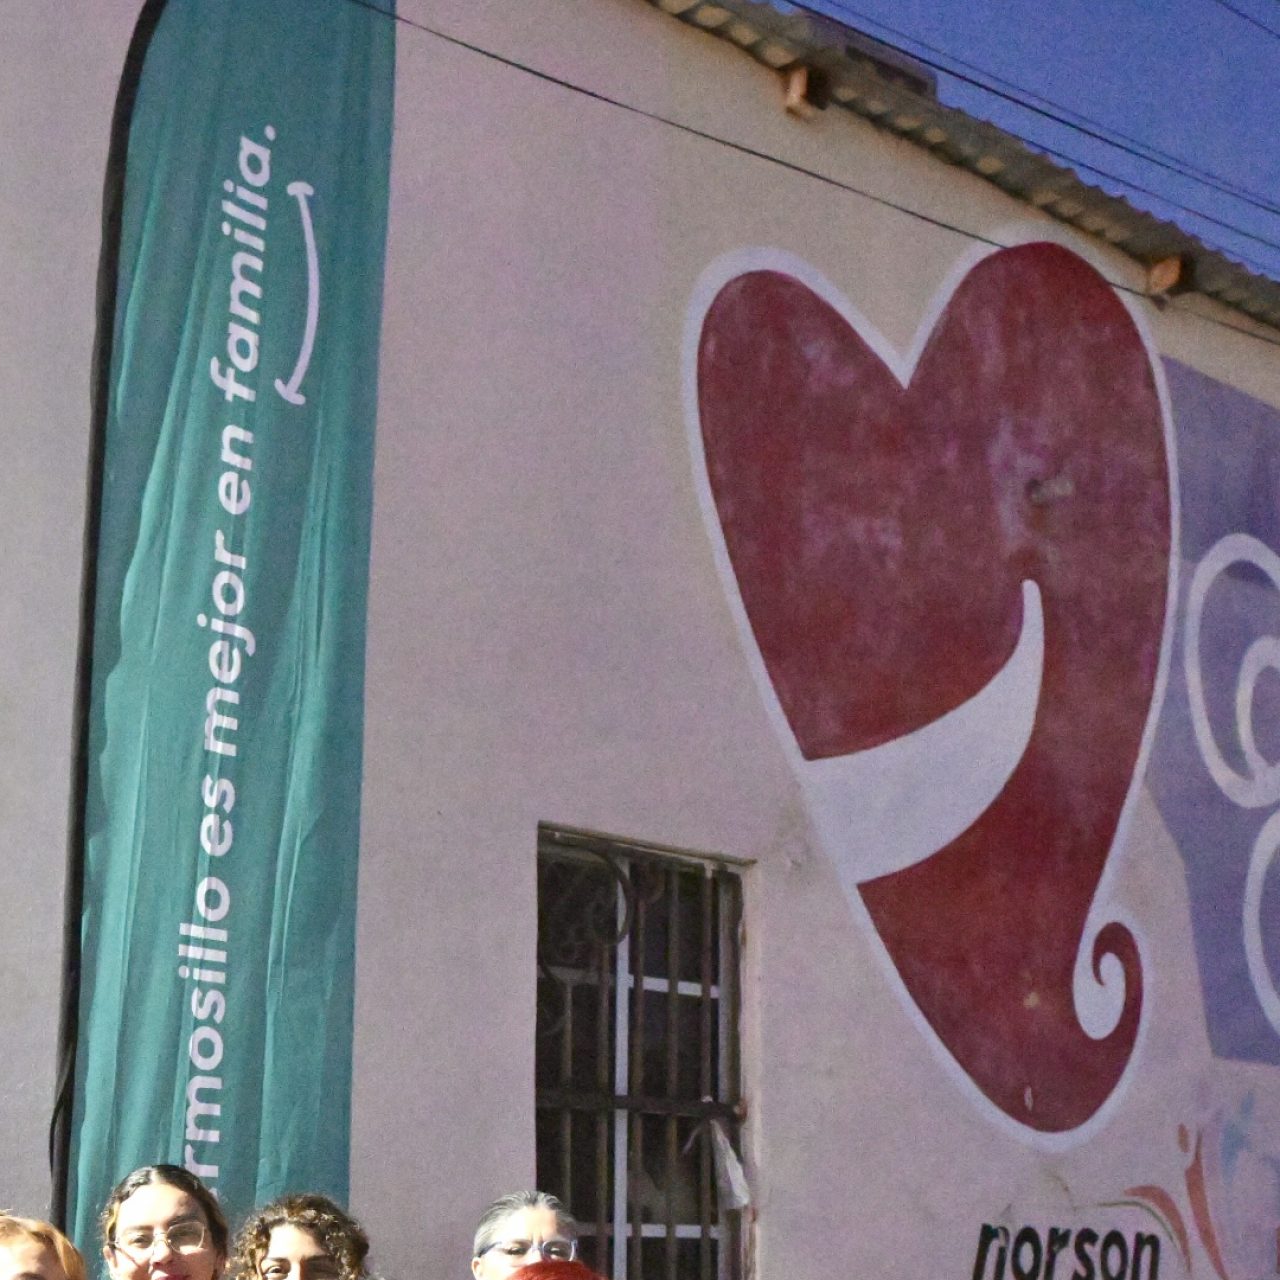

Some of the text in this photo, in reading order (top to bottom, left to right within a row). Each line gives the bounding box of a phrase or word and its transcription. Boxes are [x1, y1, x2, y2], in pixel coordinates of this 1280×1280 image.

[179, 125, 277, 1201] rmosillo es mejor en familia.
